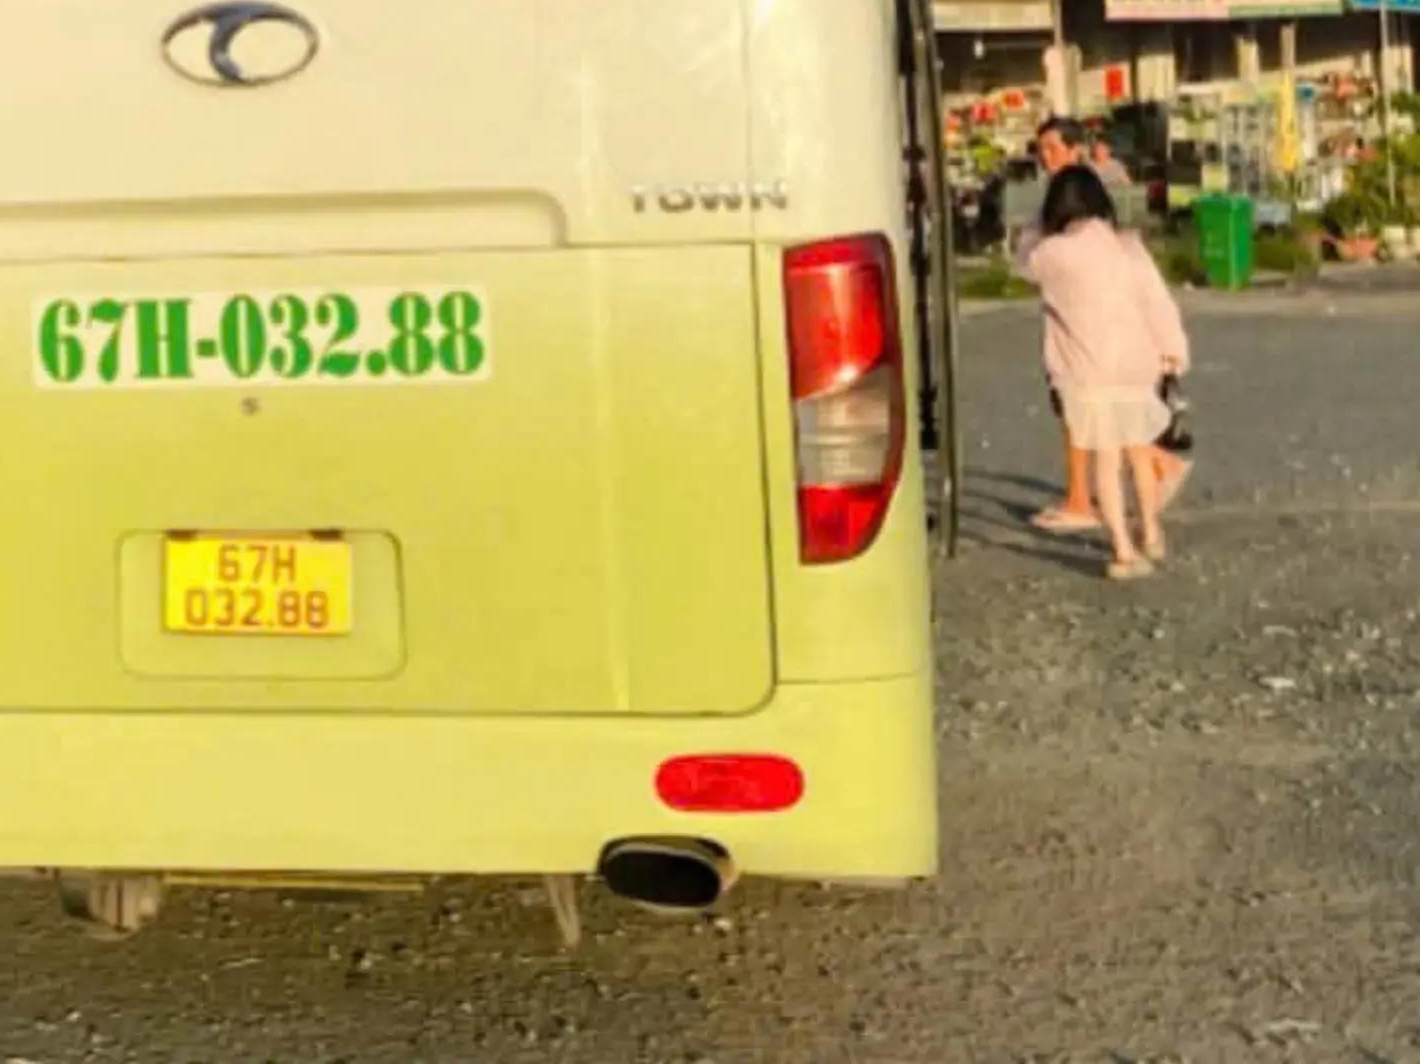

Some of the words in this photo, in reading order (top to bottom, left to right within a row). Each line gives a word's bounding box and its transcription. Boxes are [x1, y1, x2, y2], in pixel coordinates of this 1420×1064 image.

[625, 178, 788, 213] TOWN
[37, 290, 486, 384] 67H-032.88
[217, 543, 297, 583] 67H
[184, 588, 329, 629] 032.88
